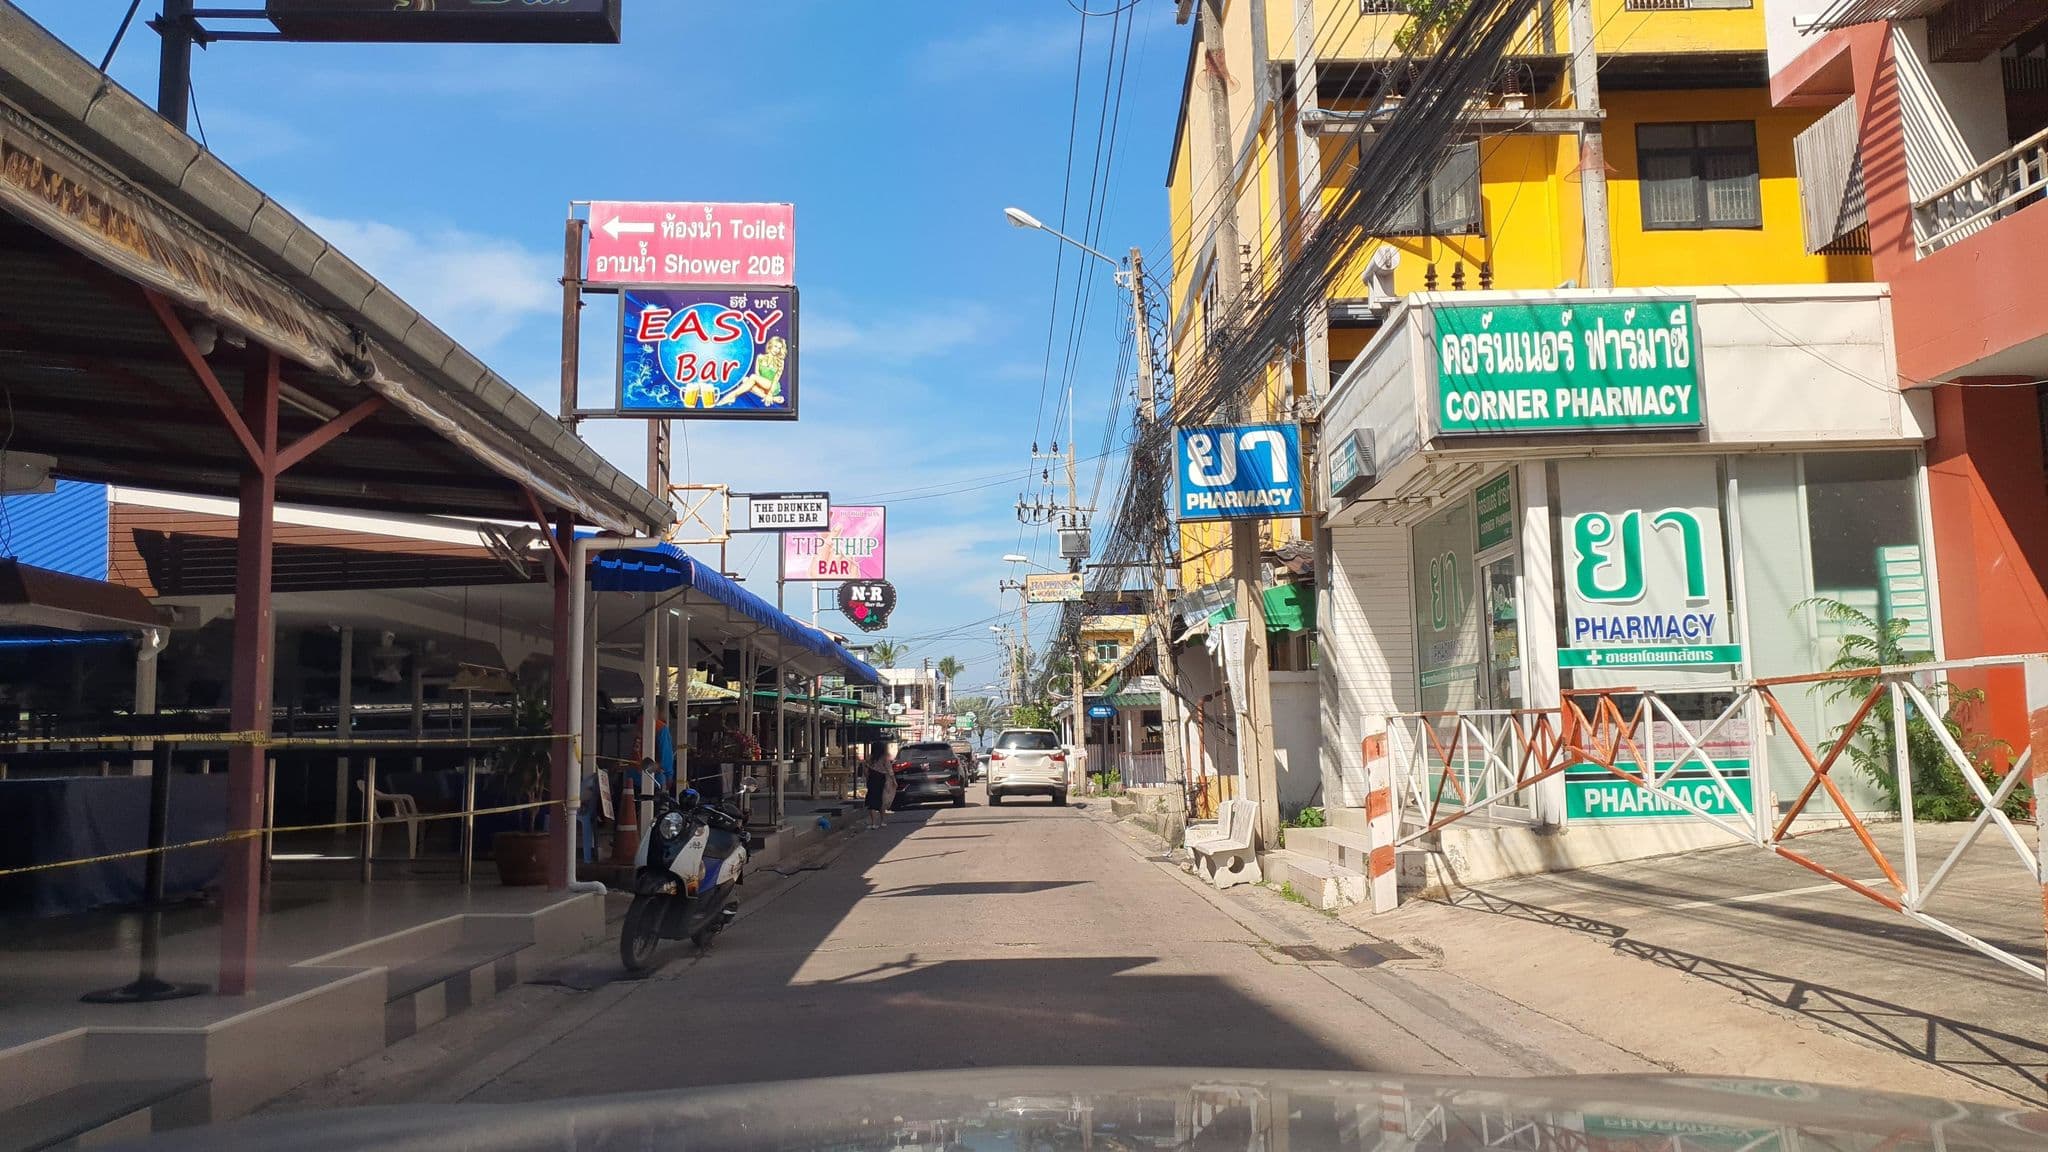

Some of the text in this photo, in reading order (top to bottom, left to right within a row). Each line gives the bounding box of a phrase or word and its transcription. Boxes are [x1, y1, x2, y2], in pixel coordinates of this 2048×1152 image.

[661, 207, 785, 240] ห้องน้ำ Toilet
[596, 241, 656, 273] อาบน้ำ
[664, 254, 740, 275] Shower
[637, 308, 783, 344] EASY
[1442, 304, 1690, 375] คอร์นเนอร์ ฟาร์มาซี
[675, 353, 740, 382] Bar
[1446, 384, 1692, 422] CORNER PHARMACY
[1187, 430, 1289, 487] ยา
[754, 502, 823, 513] THE DRUNKEN
[1186, 488, 1293, 510] PHARMACY
[758, 513, 818, 523] NOODLE BAR
[792, 537, 878, 556] TIP THIP
[1573, 507, 1710, 604] ยา
[819, 560, 849, 575] BAR
[851, 586, 883, 601] N-R
[1575, 613, 1716, 641] PHARMACY
[1584, 784, 1728, 813] PHARMACY
